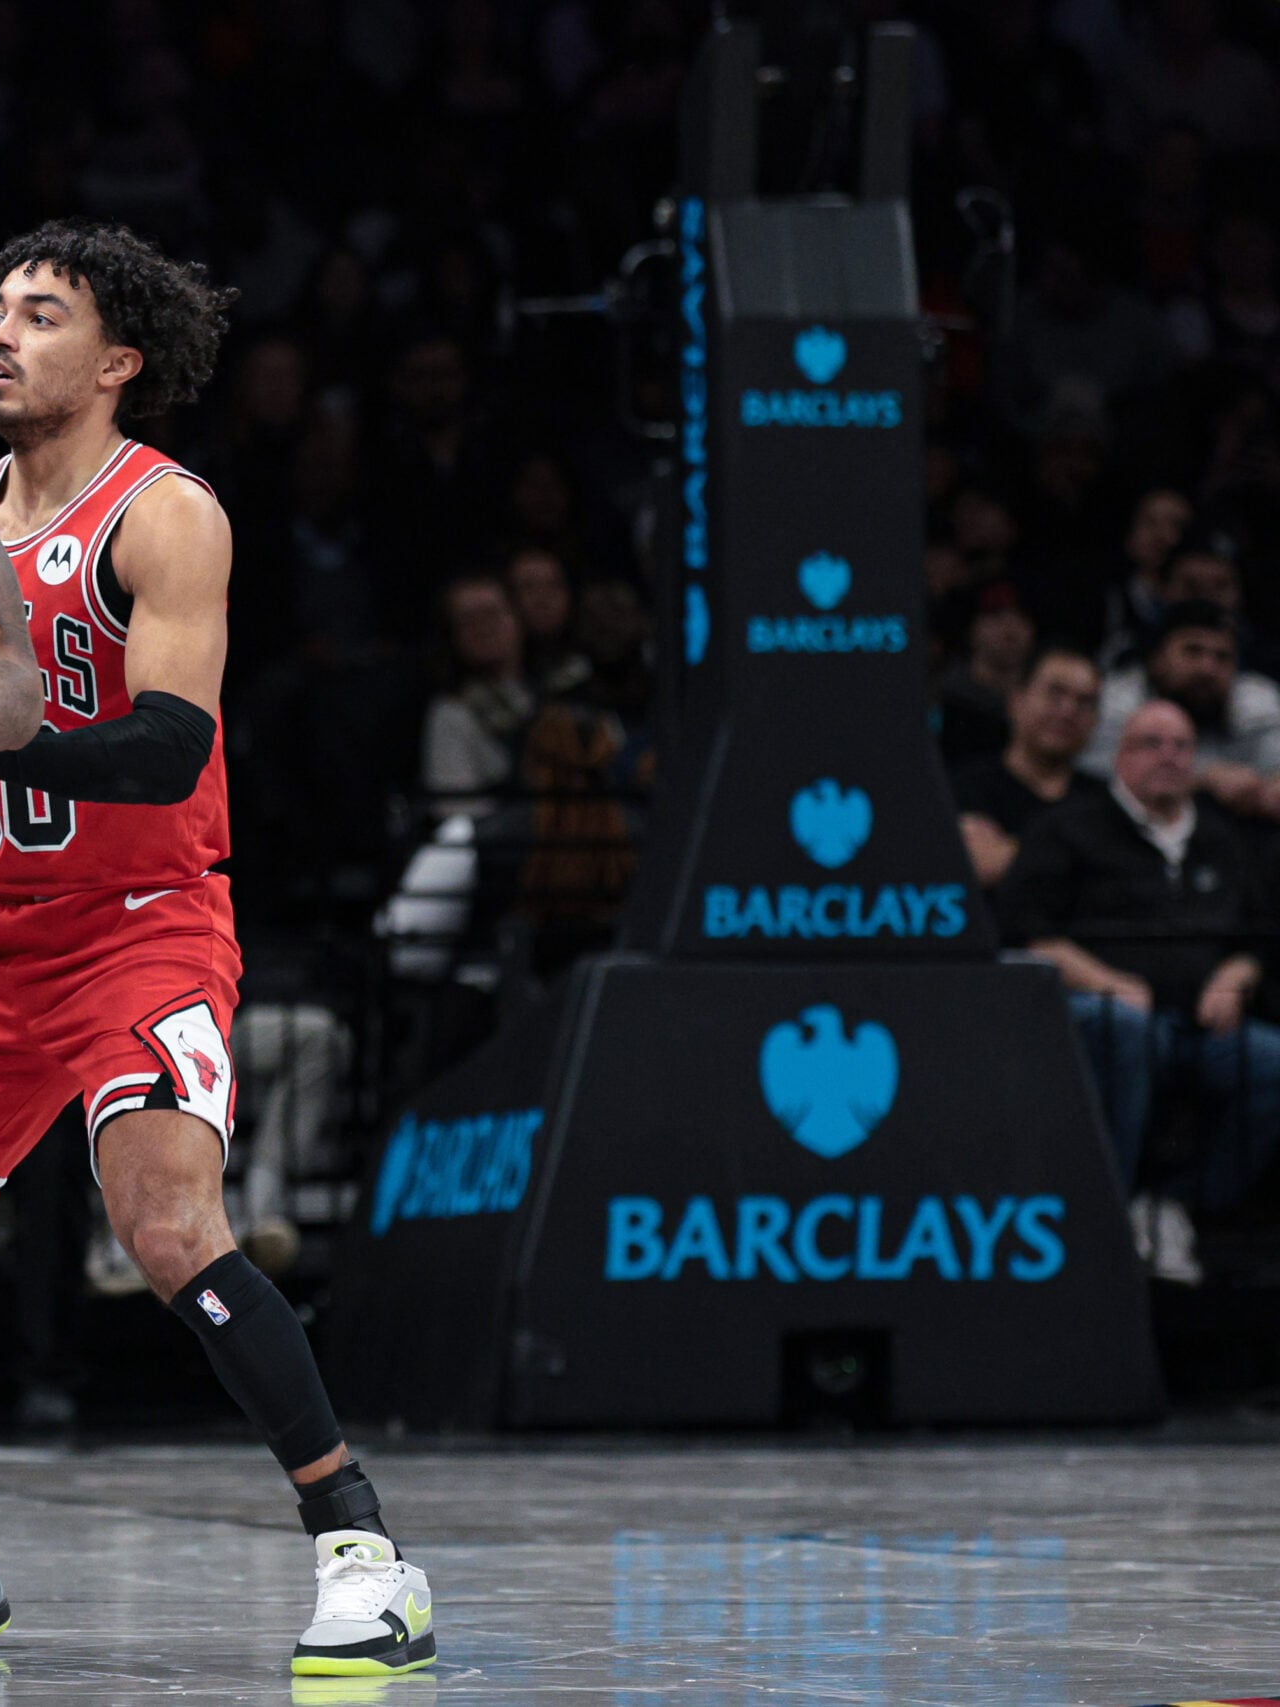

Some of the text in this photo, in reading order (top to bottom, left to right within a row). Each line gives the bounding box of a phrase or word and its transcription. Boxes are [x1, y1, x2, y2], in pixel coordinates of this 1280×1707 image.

[741, 389, 902, 428] BARCLAYS
[747, 616, 908, 653] BARCLAYS
[703, 882, 968, 939] BARCLAYS
[604, 1193, 1066, 1283] BARCLAYS
